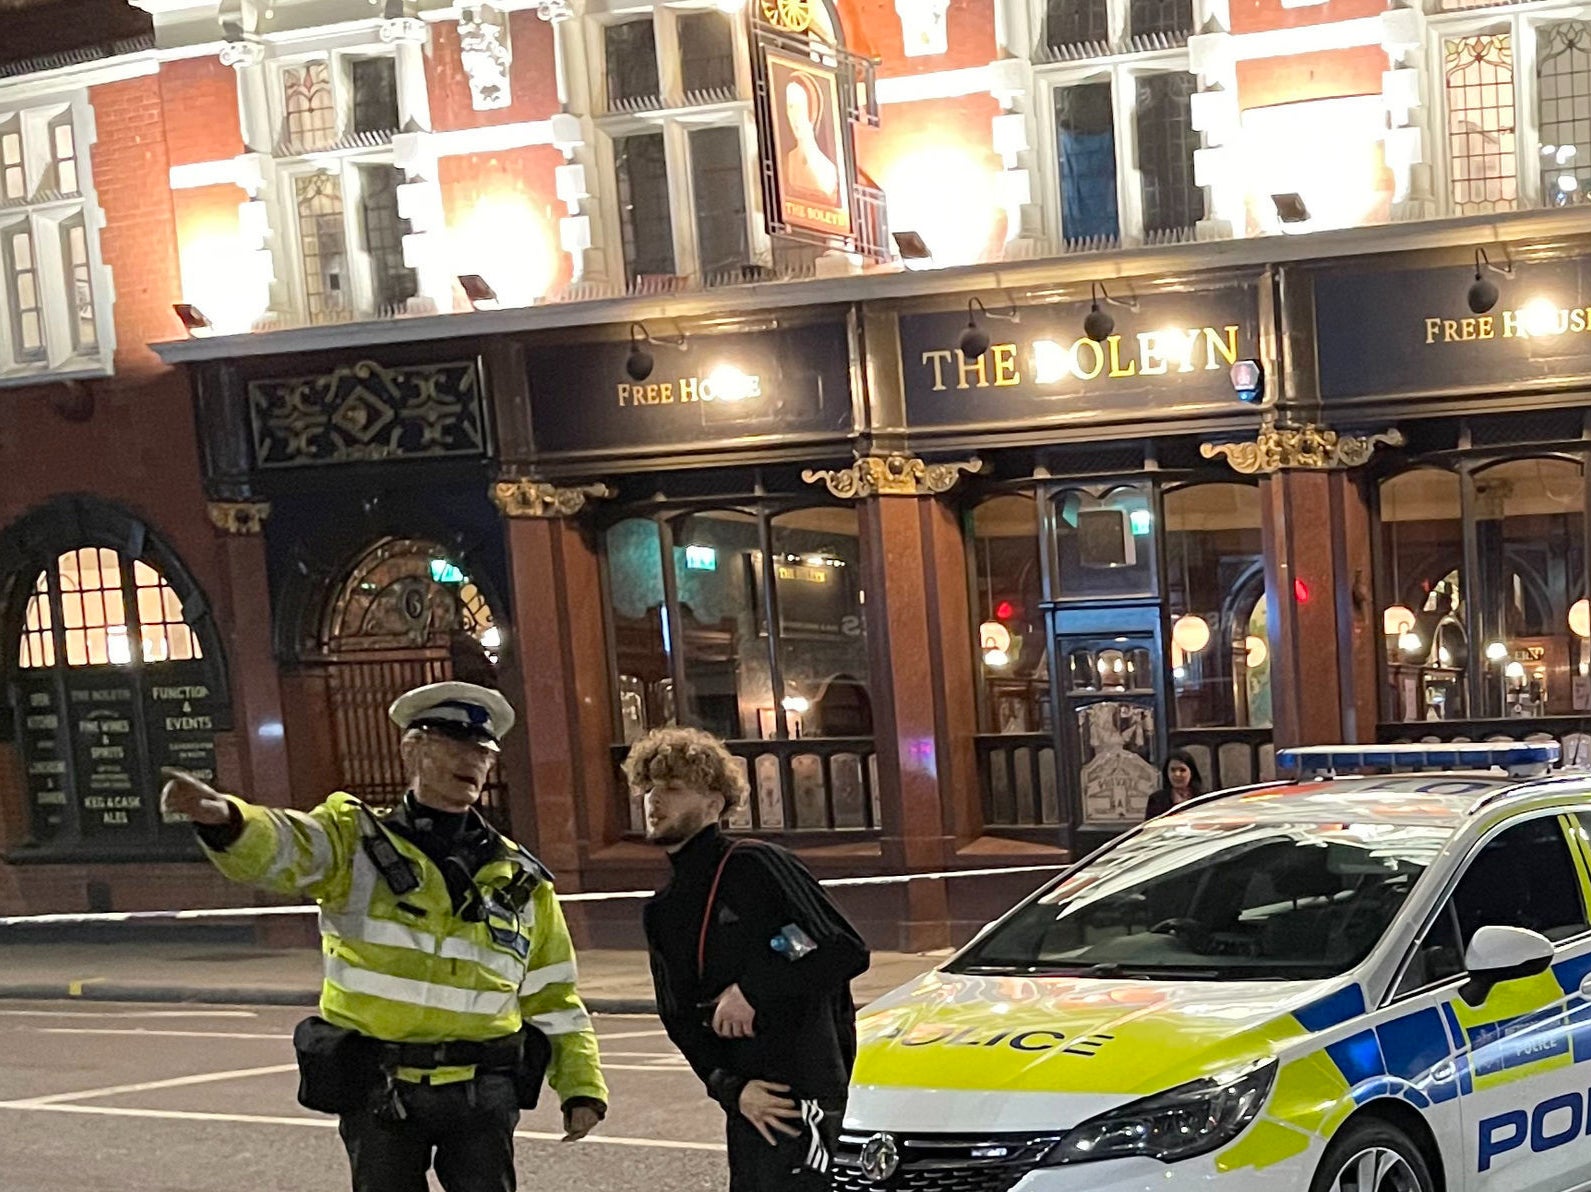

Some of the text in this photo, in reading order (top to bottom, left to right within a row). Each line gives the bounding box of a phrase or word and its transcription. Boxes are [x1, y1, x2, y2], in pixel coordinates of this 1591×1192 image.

[1425, 316, 1495, 344] FREE
[923, 343, 1021, 391] THE
[617, 383, 674, 406] FREE
[165, 716, 213, 731] EVENTS
[1516, 1039, 1558, 1057] POLICE
